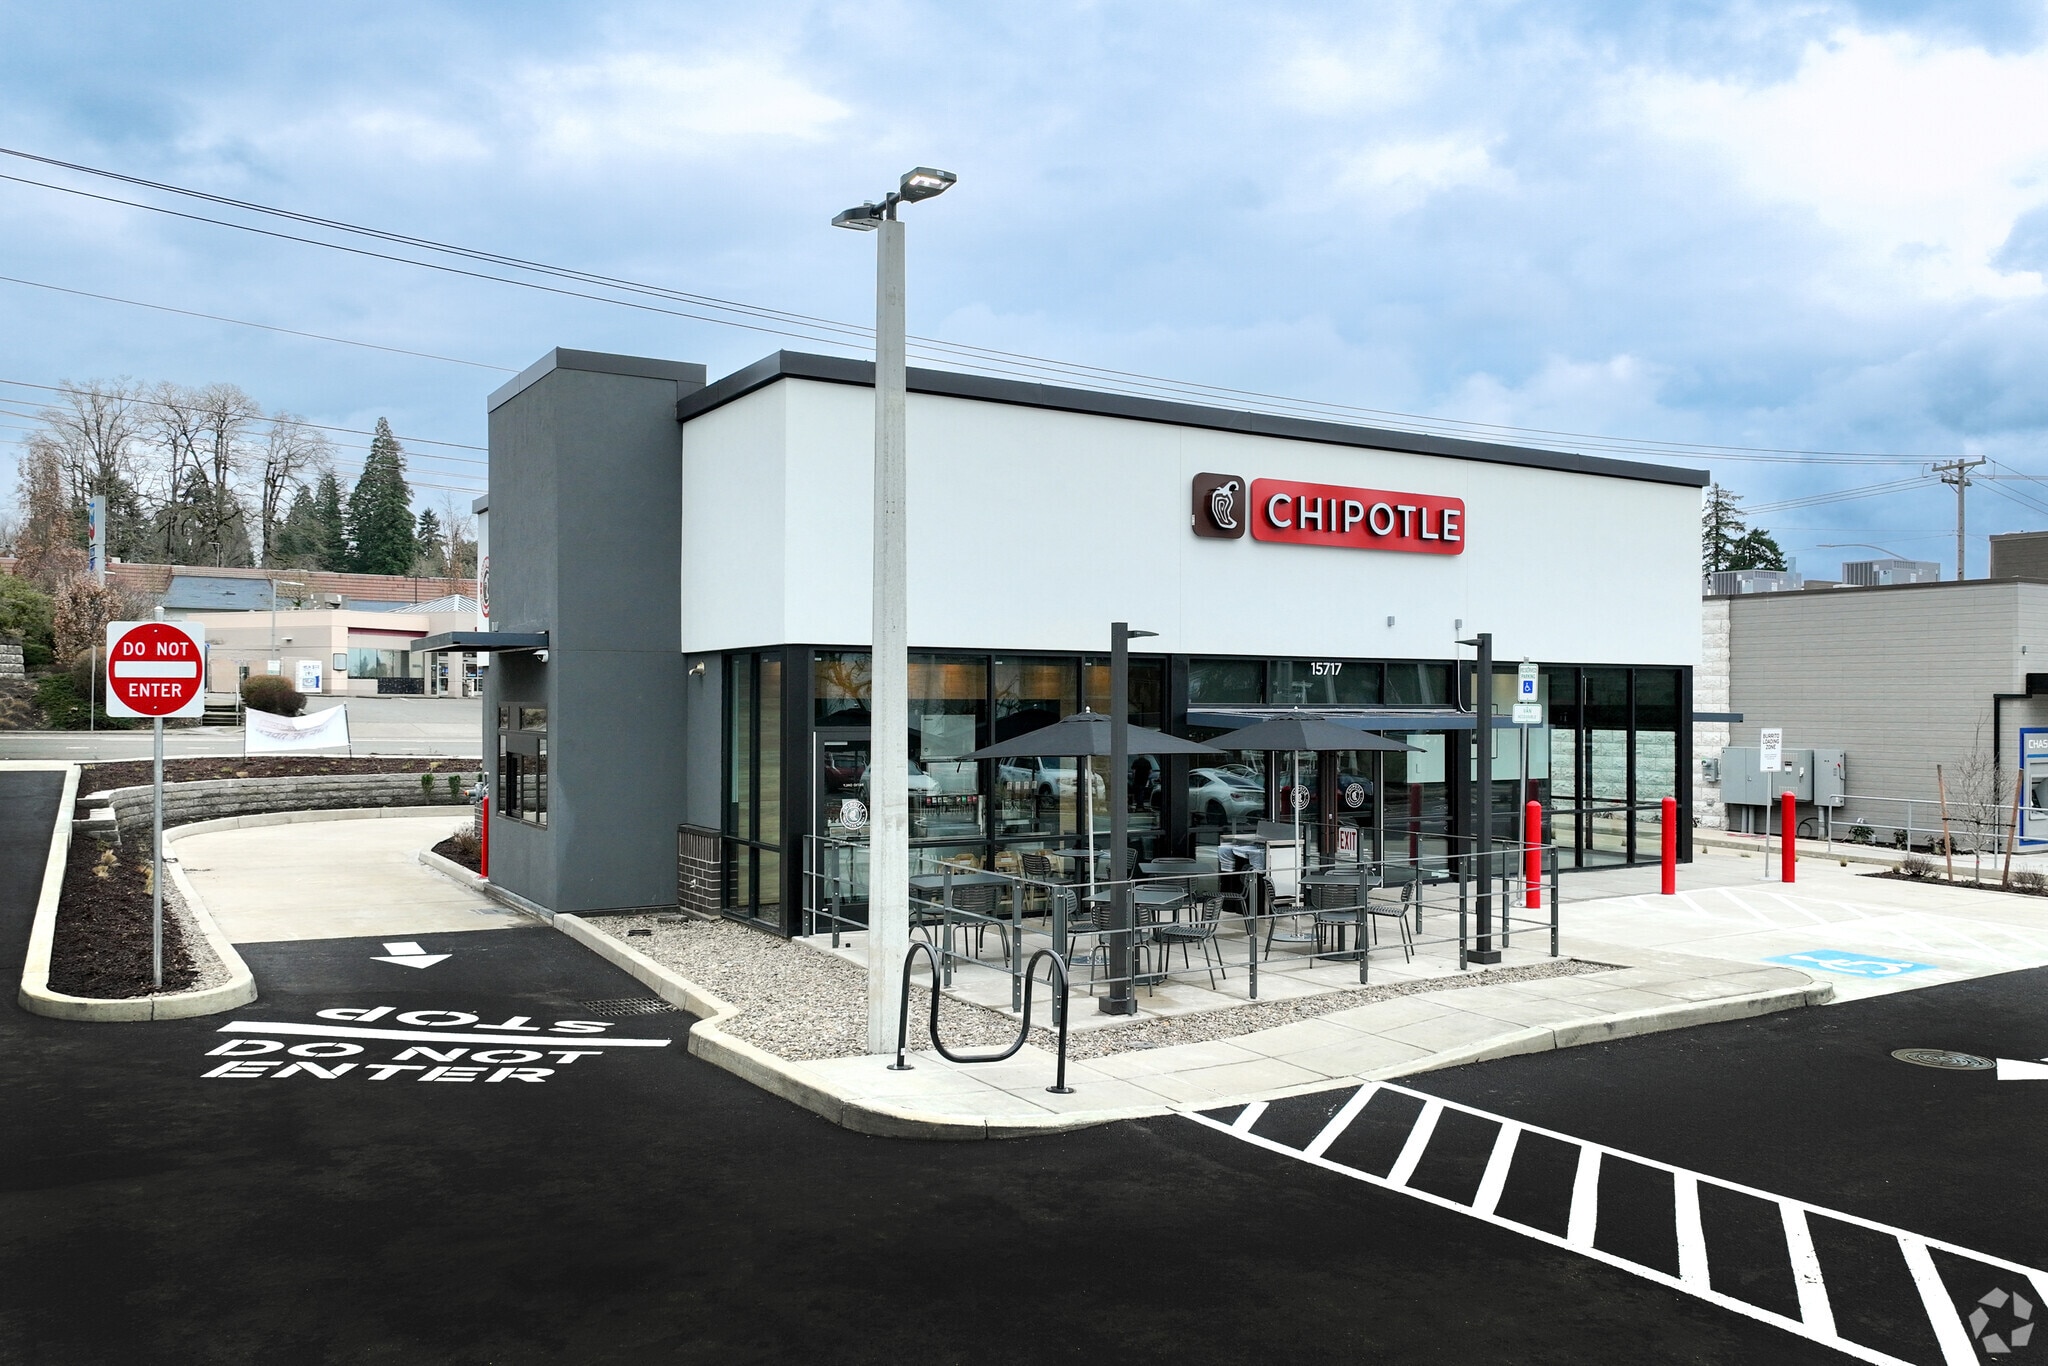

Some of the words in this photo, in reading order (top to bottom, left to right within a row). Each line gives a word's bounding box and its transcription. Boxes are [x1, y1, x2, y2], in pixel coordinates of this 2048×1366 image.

[1268, 493, 1461, 541] CHIPOTLE
[123, 642, 146, 656] DO
[157, 642, 189, 656] NOT
[1310, 662, 1342, 676] 15717
[128, 683, 182, 697] ENTER
[2028, 739, 2048, 749] CHAS
[1340, 830, 1357, 851] EXIT
[316, 1006, 615, 1032] STOP
[204, 1039, 365, 1058] DO
[392, 1046, 604, 1064] NOT
[200, 1061, 556, 1083] ENTER
